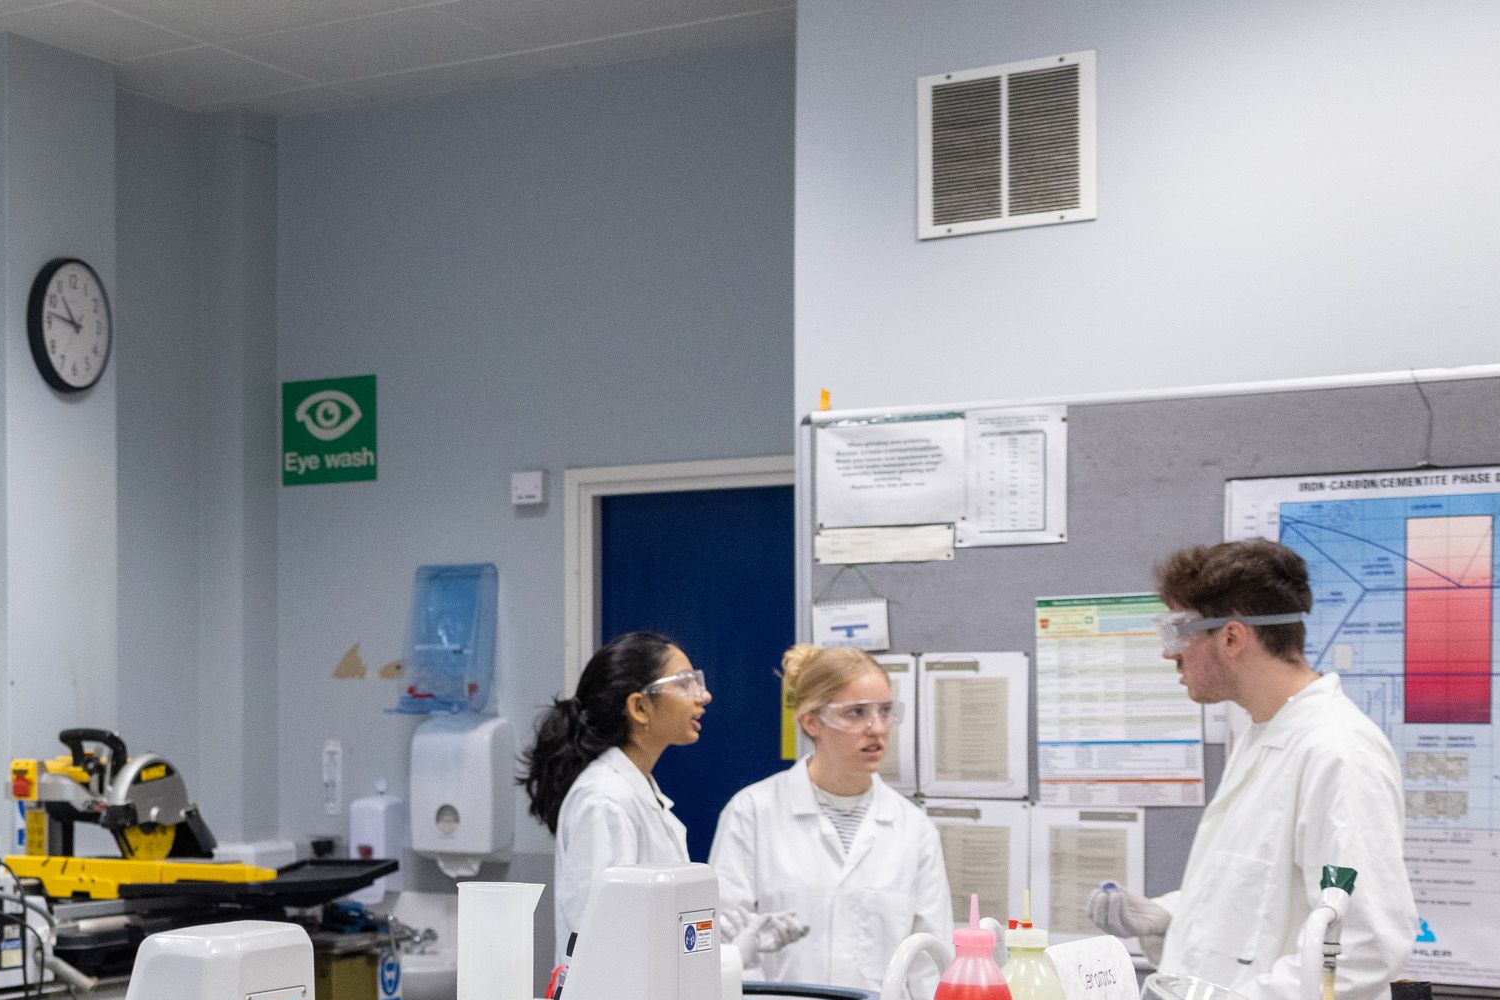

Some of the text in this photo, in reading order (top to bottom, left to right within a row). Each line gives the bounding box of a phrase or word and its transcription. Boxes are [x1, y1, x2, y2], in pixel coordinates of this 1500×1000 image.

[285, 446, 376, 475] Eye wash
[1452, 472, 1491, 485] PHASE
[1078, 963, 1117, 990] Ceramics
